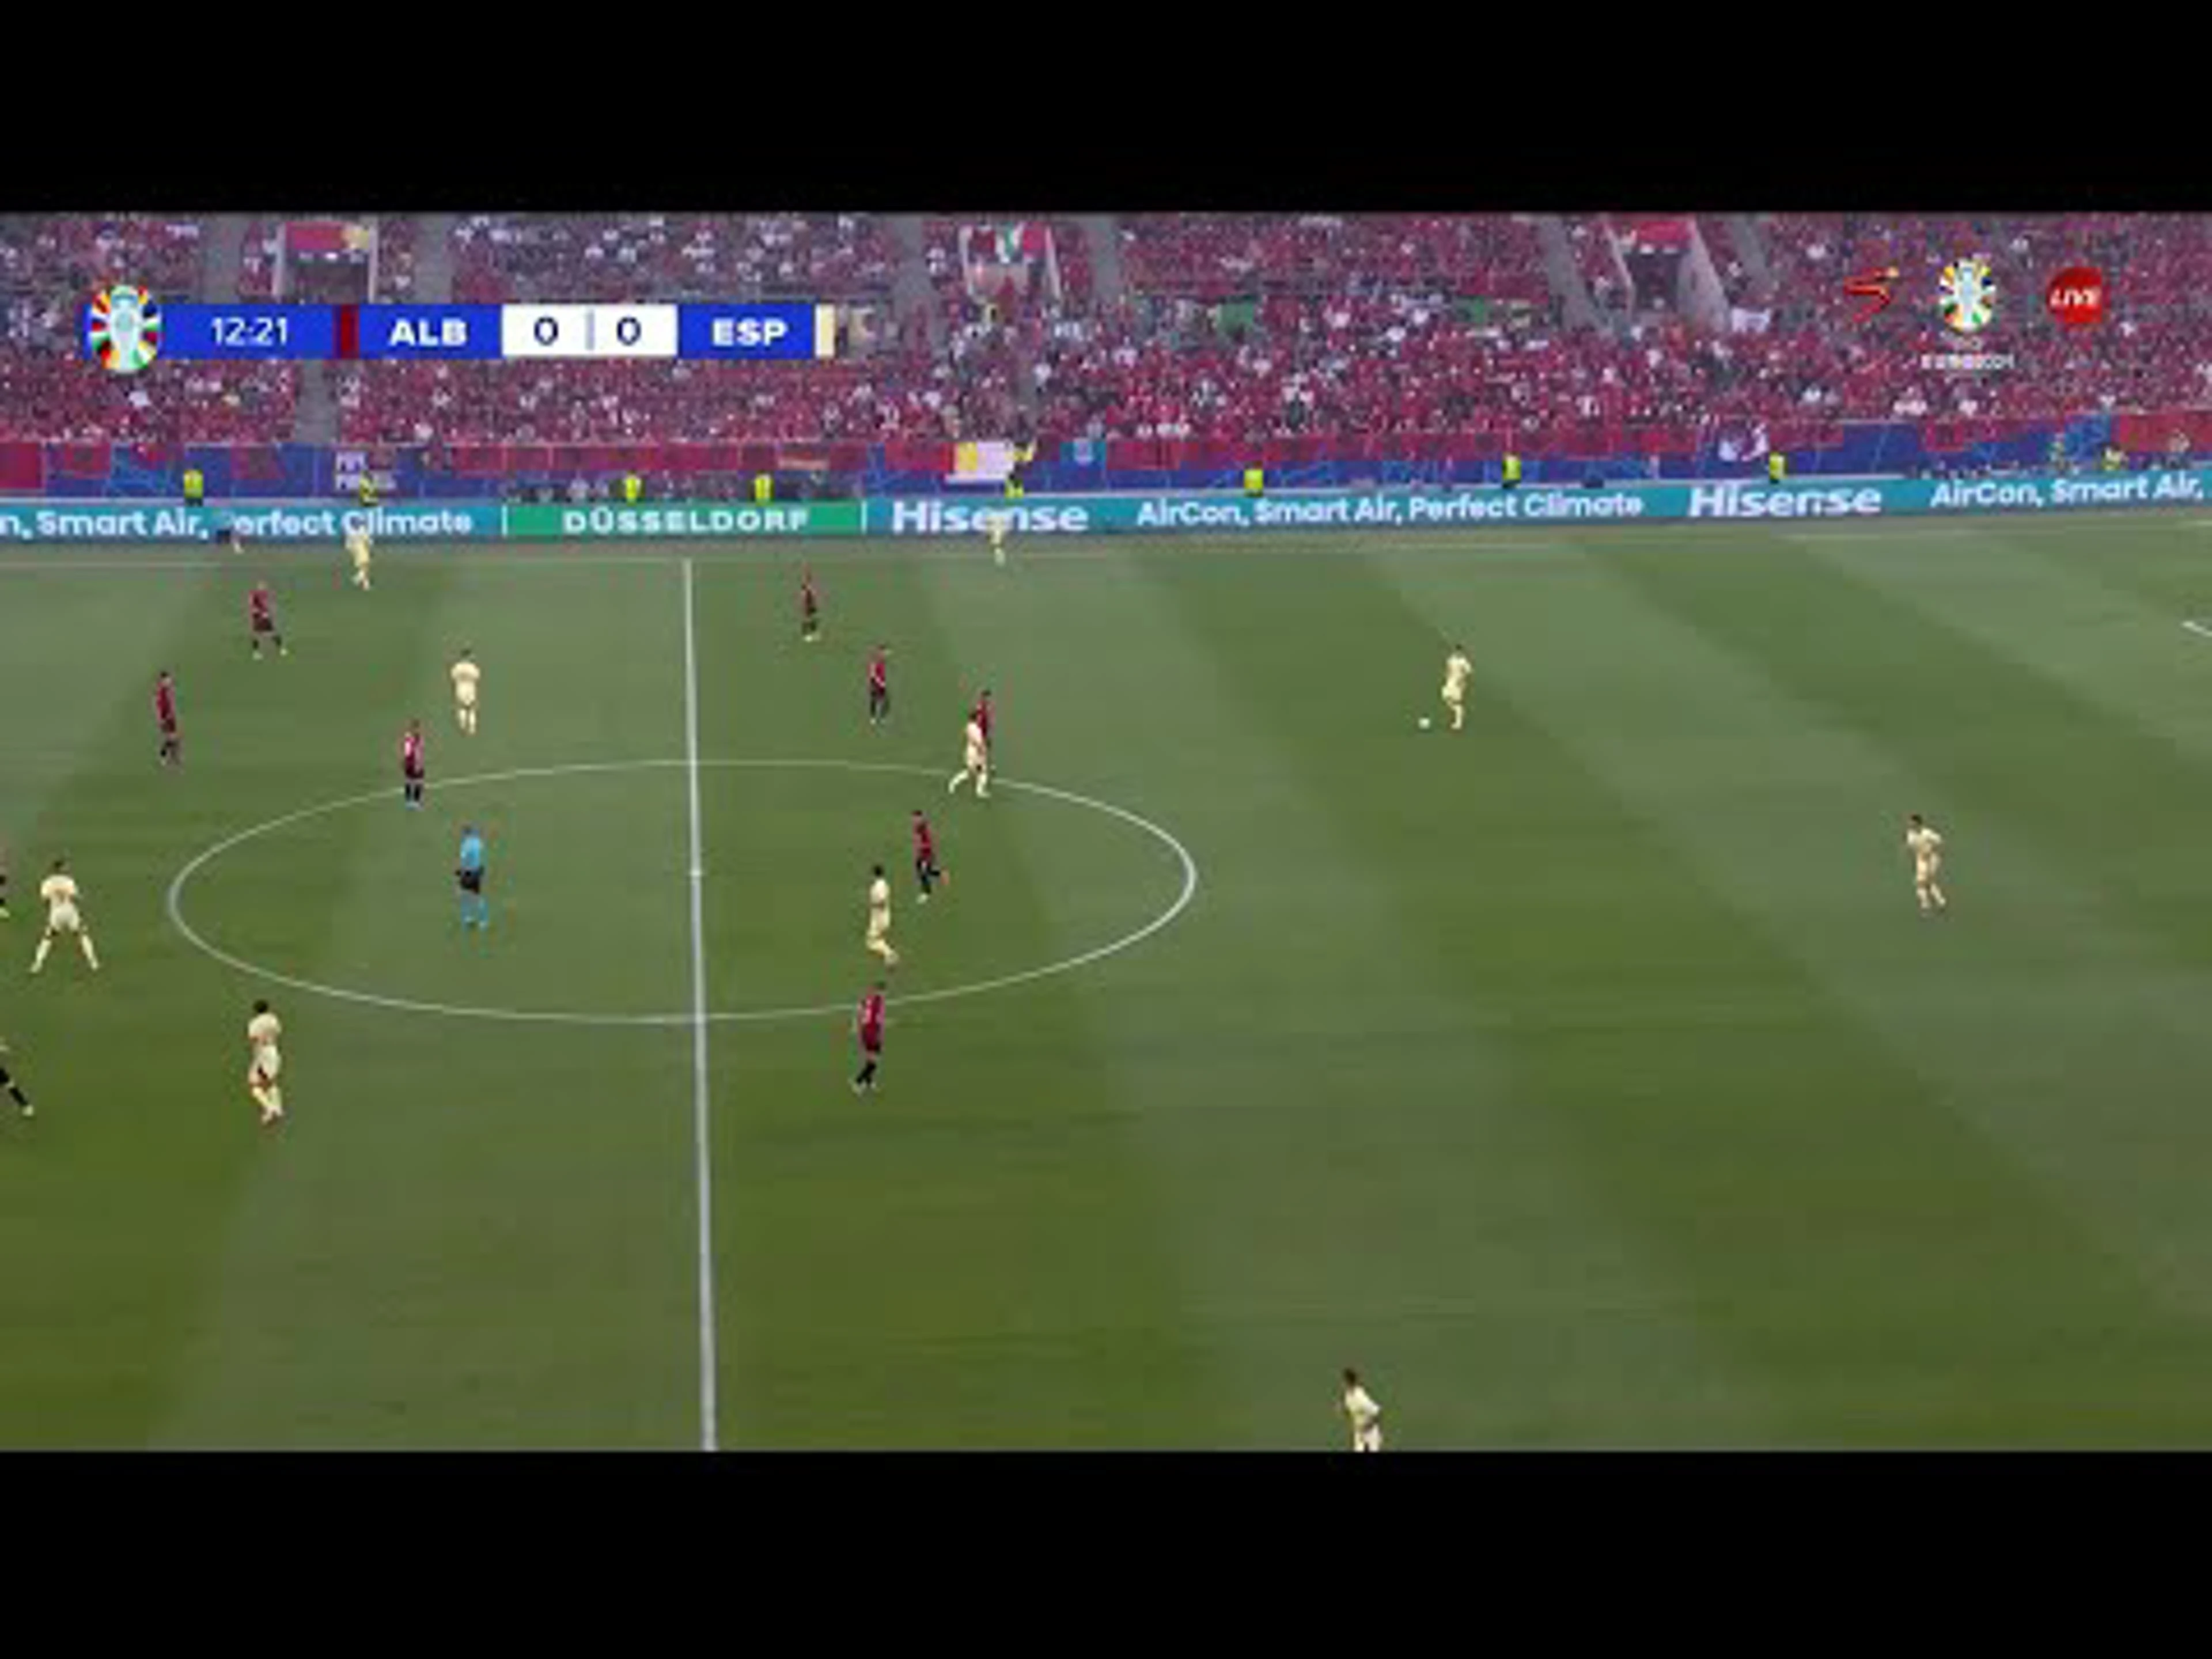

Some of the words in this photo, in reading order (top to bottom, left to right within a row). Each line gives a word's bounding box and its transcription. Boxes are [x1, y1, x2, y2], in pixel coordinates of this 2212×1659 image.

[1688, 481, 1881, 518] Hisense
[1930, 479, 2044, 508] AirCon,
[2052, 476, 2150, 502] Smart
[37, 509, 147, 535] Smart
[341, 506, 472, 535] Climate
[563, 505, 809, 533] DÜSSELDORF
[1136, 499, 1249, 528] AirCon,
[1255, 499, 1349, 524] Smart
[1409, 495, 1519, 521] Perfect
[1524, 493, 1645, 519] Climate
